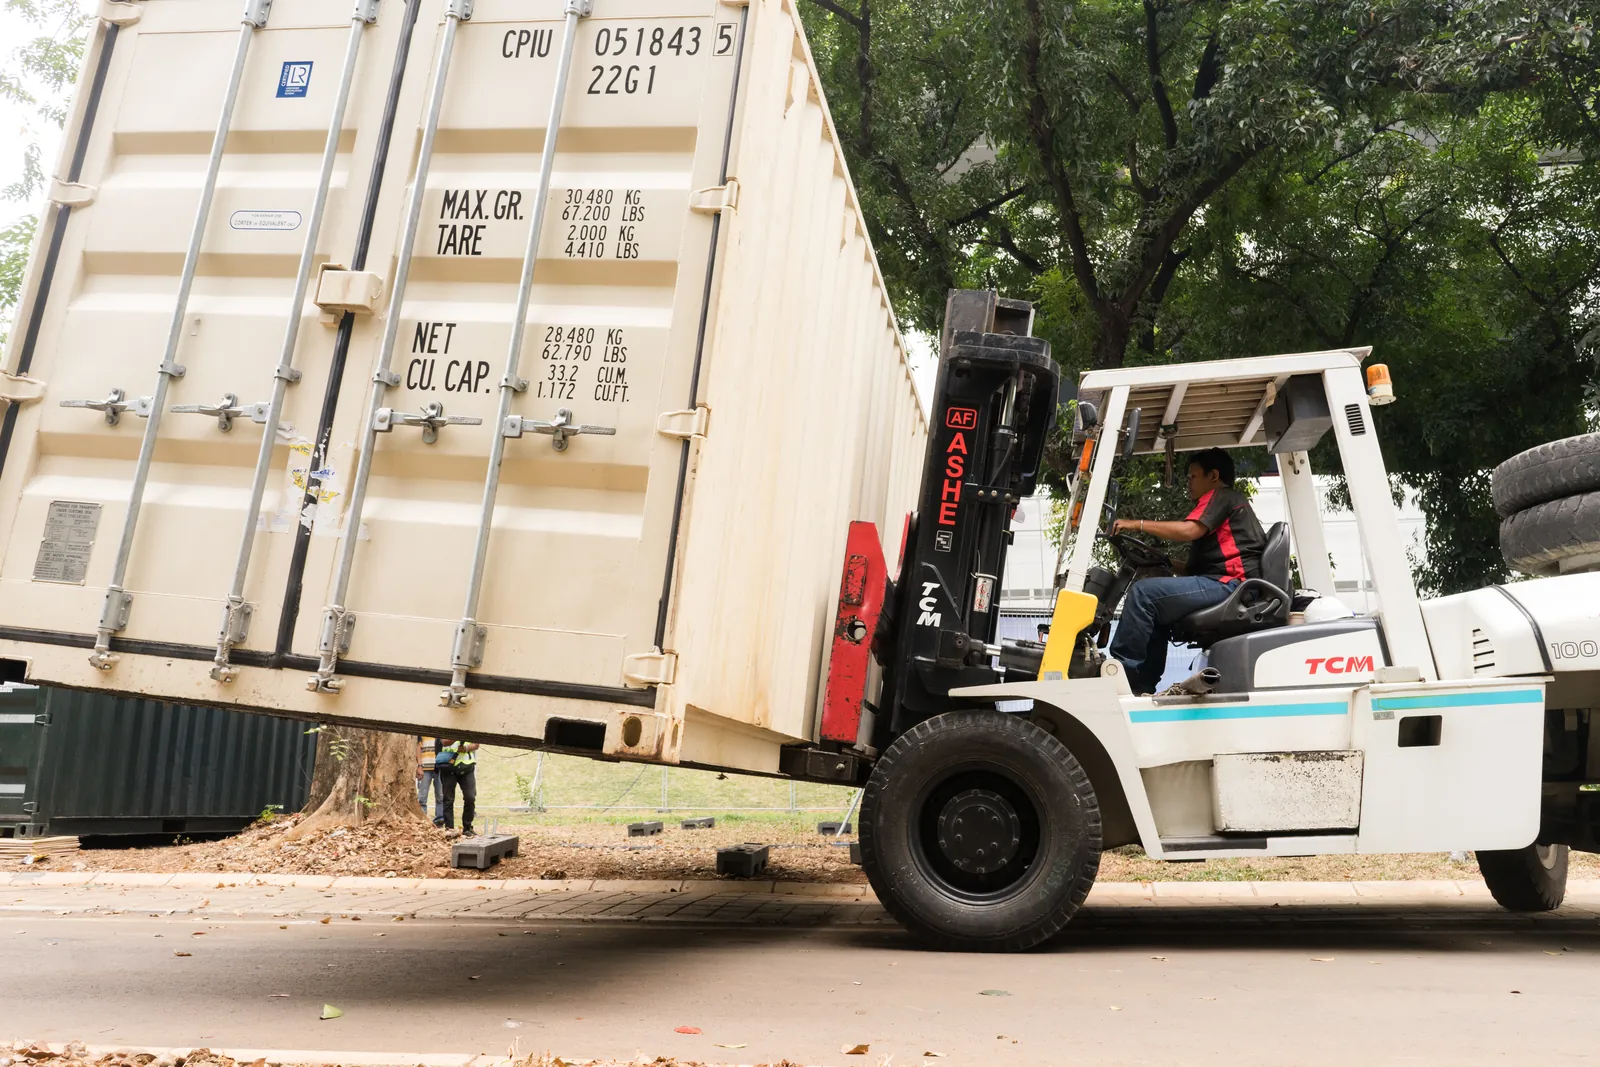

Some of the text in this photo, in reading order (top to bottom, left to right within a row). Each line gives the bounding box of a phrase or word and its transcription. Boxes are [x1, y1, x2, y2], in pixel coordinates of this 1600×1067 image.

[502, 25, 733, 58] CPIU 051843 5
[291, 67, 307, 83] LR
[587, 65, 656, 94] 22G1
[625, 190, 641, 205] KG
[622, 206, 645, 221] LBS
[437, 224, 486, 256] TARE
[618, 226, 635, 241] KG
[616, 243, 639, 259] LBS
[412, 322, 456, 354] NET
[607, 329, 623, 345] KG
[603, 346, 628, 363] LBS
[407, 359, 490, 393] CU. CAP.
[548, 364, 579, 382] 33.2
[950, 411, 973, 425] AF
[938, 432, 968, 526] ASHE
[916, 581, 942, 628] TCM
[1551, 640, 1598, 659] 100
[1305, 656, 1374, 674] TCM
